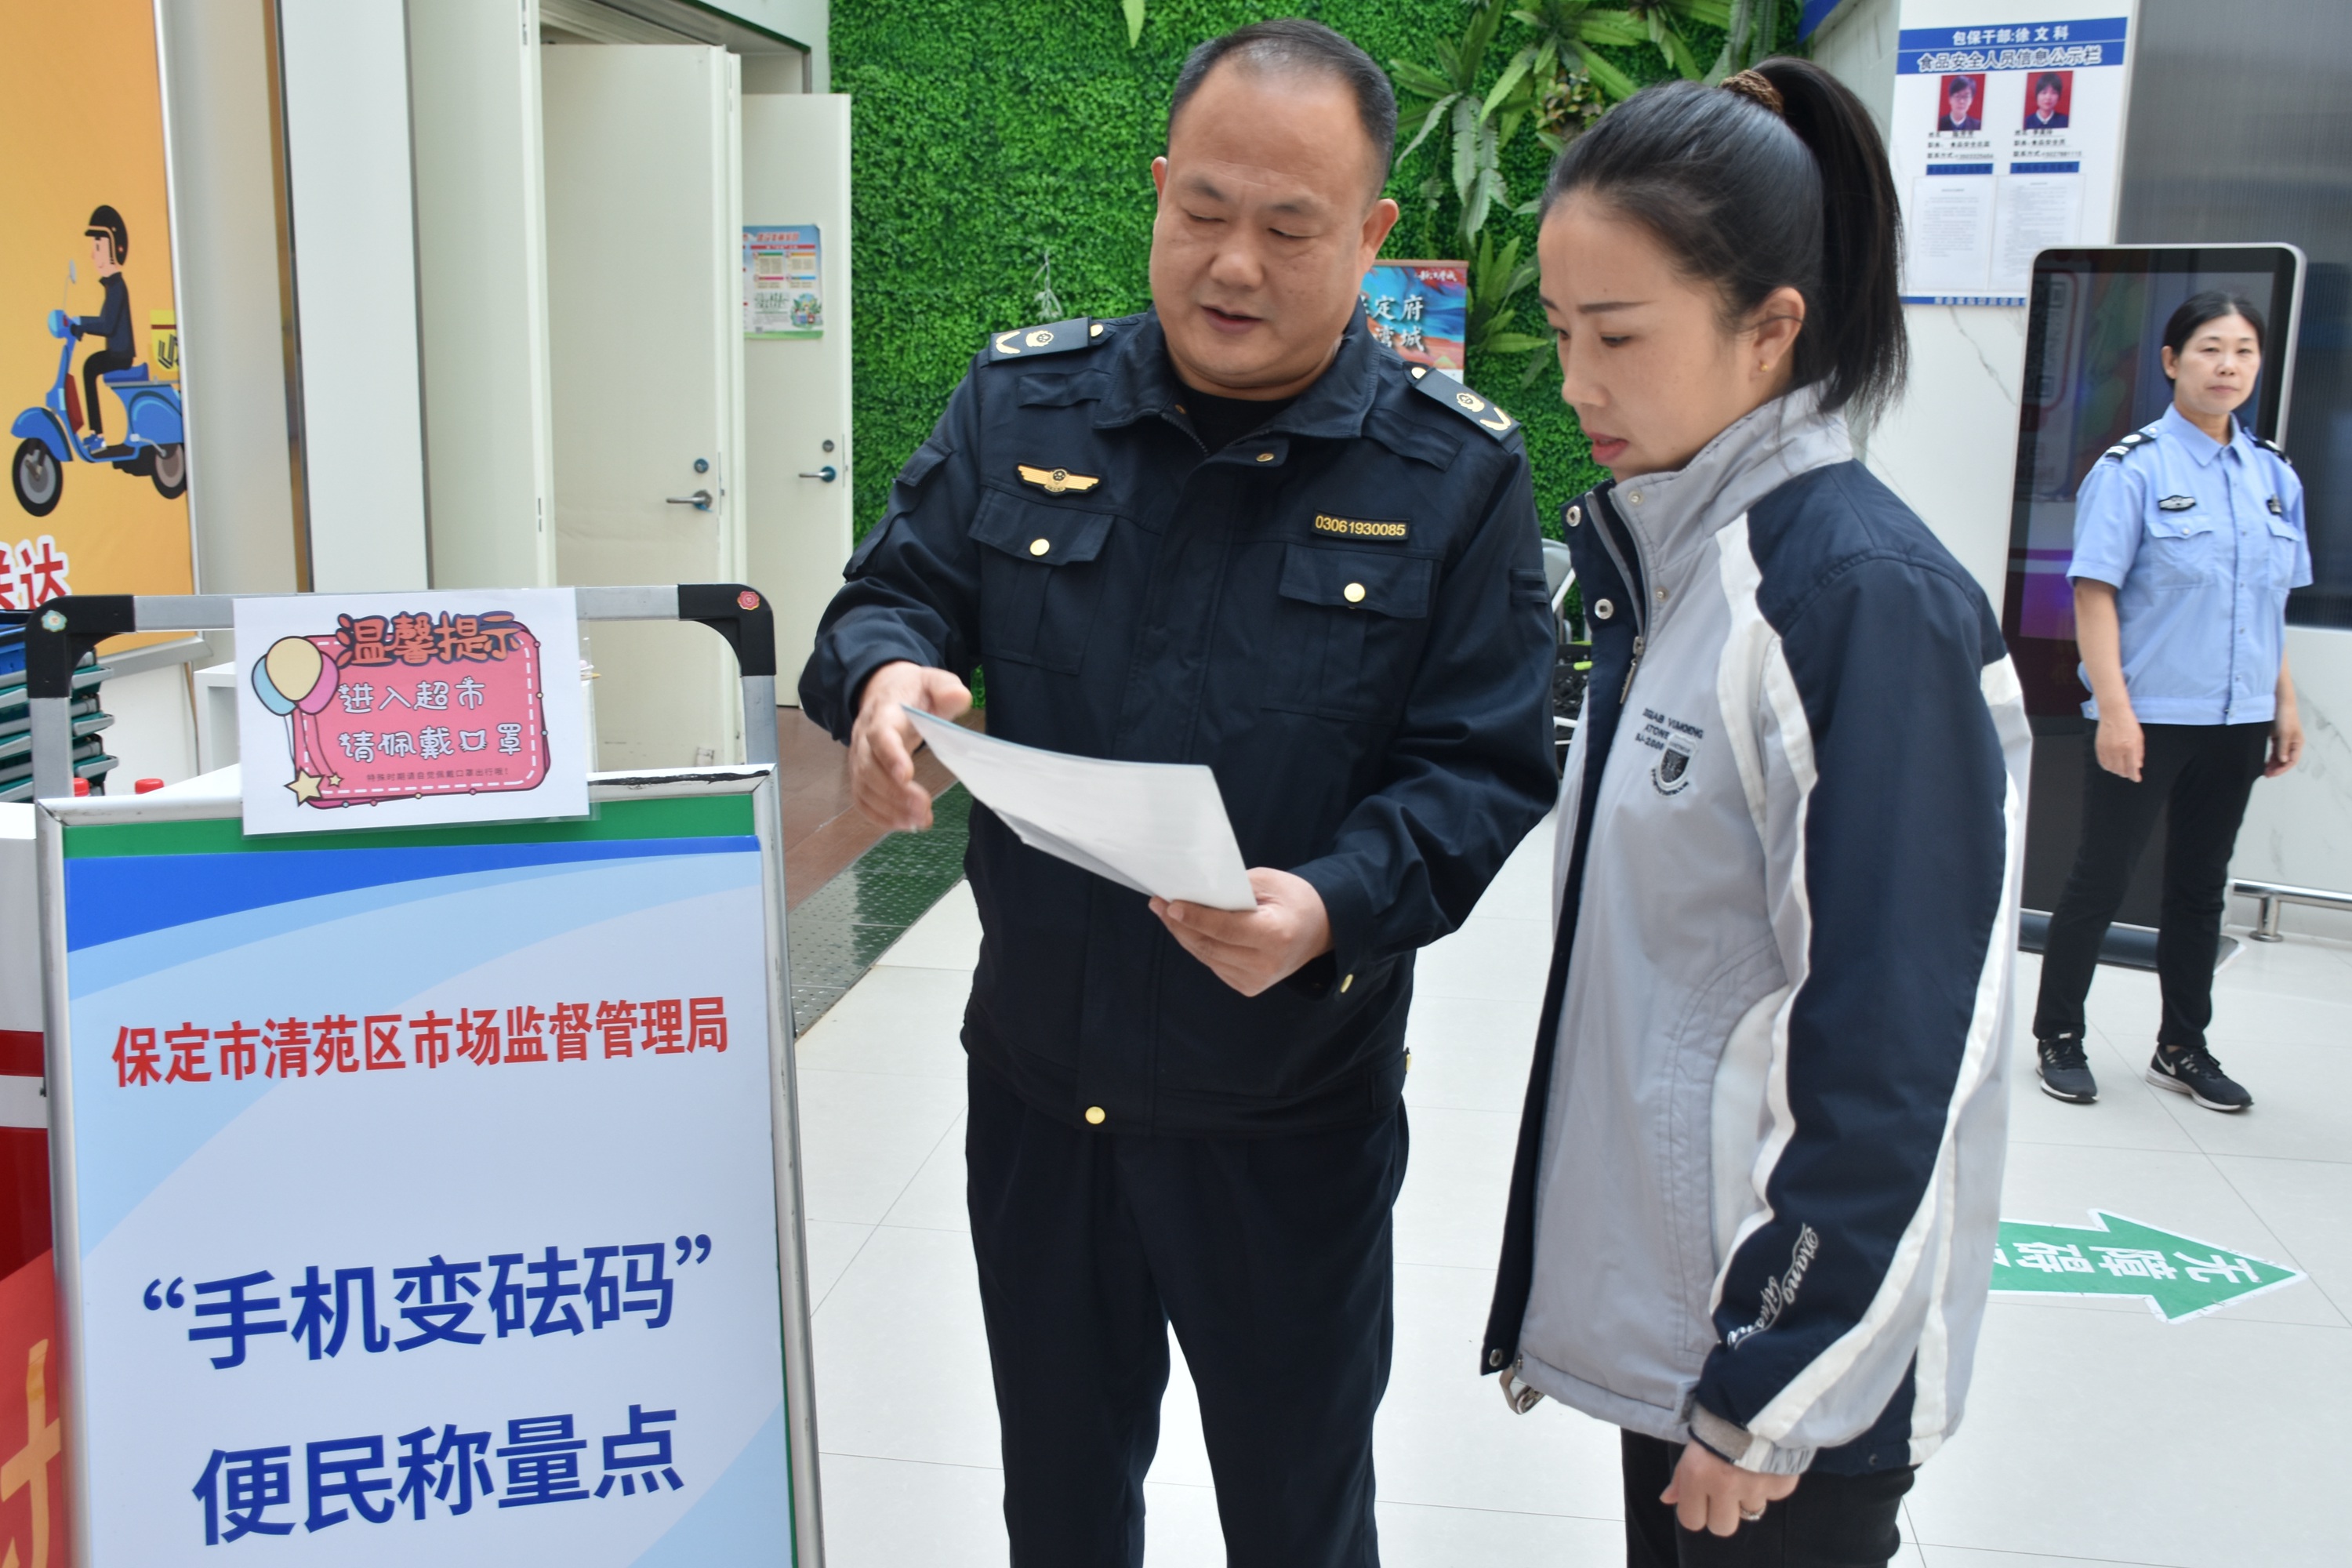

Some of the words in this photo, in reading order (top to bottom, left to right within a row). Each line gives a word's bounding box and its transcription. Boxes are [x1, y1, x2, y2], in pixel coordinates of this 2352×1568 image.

[1917, 45, 2103, 71] 食品安全人员信息公示栏
[1315, 514, 1406, 536] 03061930085
[335, 611, 521, 669] 温馨提示
[338, 676, 485, 713] 进入超市
[338, 722, 522, 763] 请佩戴口罩
[112, 996, 729, 1088] 保定市清苑区市场监督管理局
[143, 1234, 713, 1370] “手机变砝码”
[191, 1403, 685, 1548] 便民称量点
